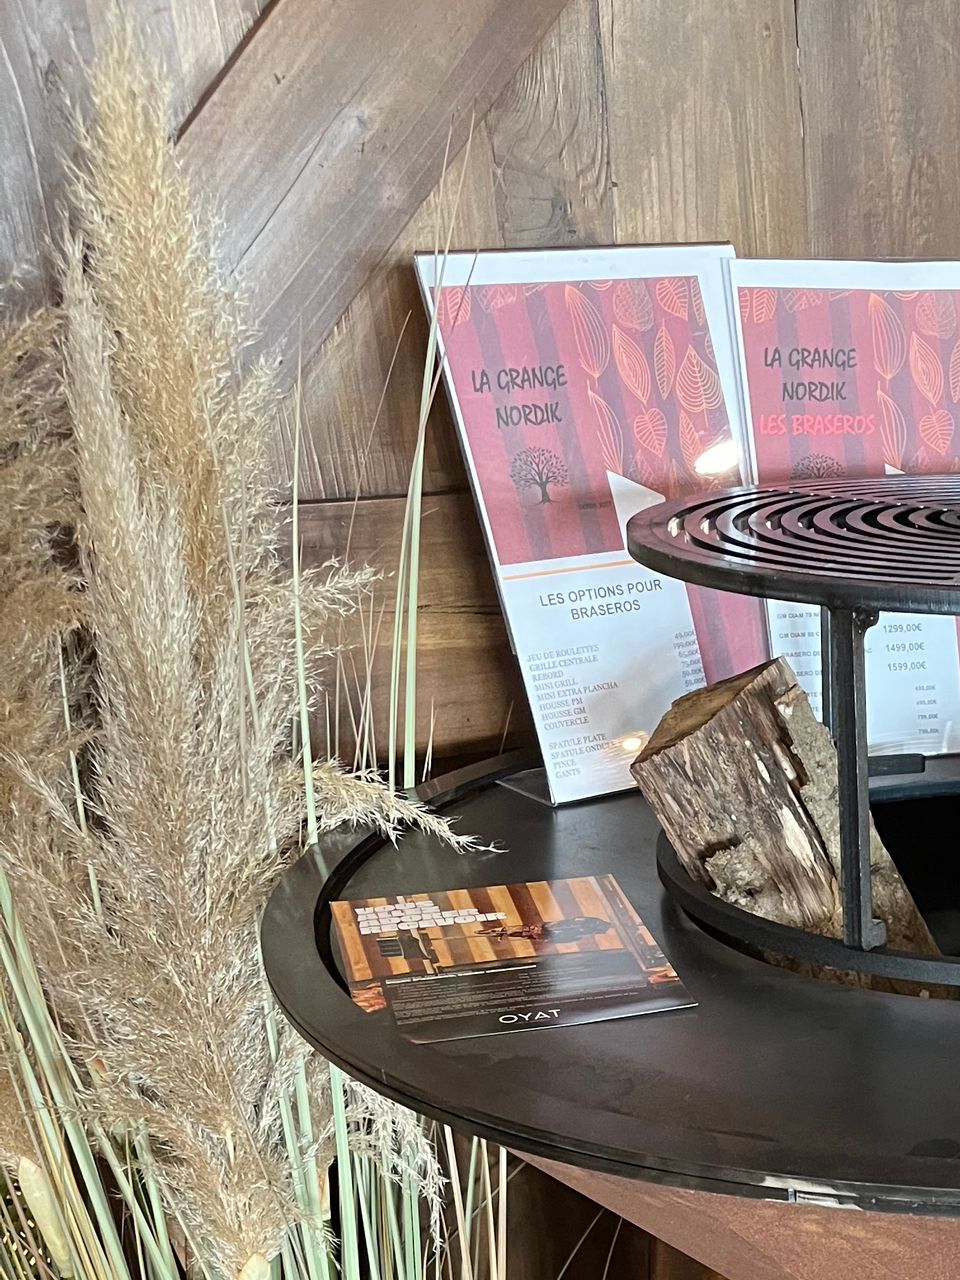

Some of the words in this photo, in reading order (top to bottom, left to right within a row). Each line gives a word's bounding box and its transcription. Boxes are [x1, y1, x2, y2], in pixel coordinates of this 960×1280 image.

[764, 347, 782, 368] LA
[788, 347, 857, 371] GRANGE
[472, 369, 491, 394] LA
[497, 364, 568, 394] GRANGE
[783, 381, 847, 402] NORDIK
[495, 401, 562, 429] NORDIK
[760, 414, 786, 436] LES
[791, 414, 876, 436] BRASEROS
[539, 593, 565, 607] LES
[568, 584, 624, 603] OPTIONS
[627, 579, 663, 594] POUR
[570, 599, 641, 620] BRASEROS
[883, 623, 923, 633] 1299,00€
[556, 644, 600, 658] ROULETTES
[886, 642, 925, 652] 1499,00€
[559, 655, 599, 668] CENTRALE
[888, 661, 927, 672] 1599,00€
[557, 687, 582, 699] EXTRA
[583, 681, 619, 695] PLANCHA
[544, 716, 590, 731] COUVERCLE
[583, 733, 607, 743] PLATE
[499, 1009, 561, 1024] OYAT
